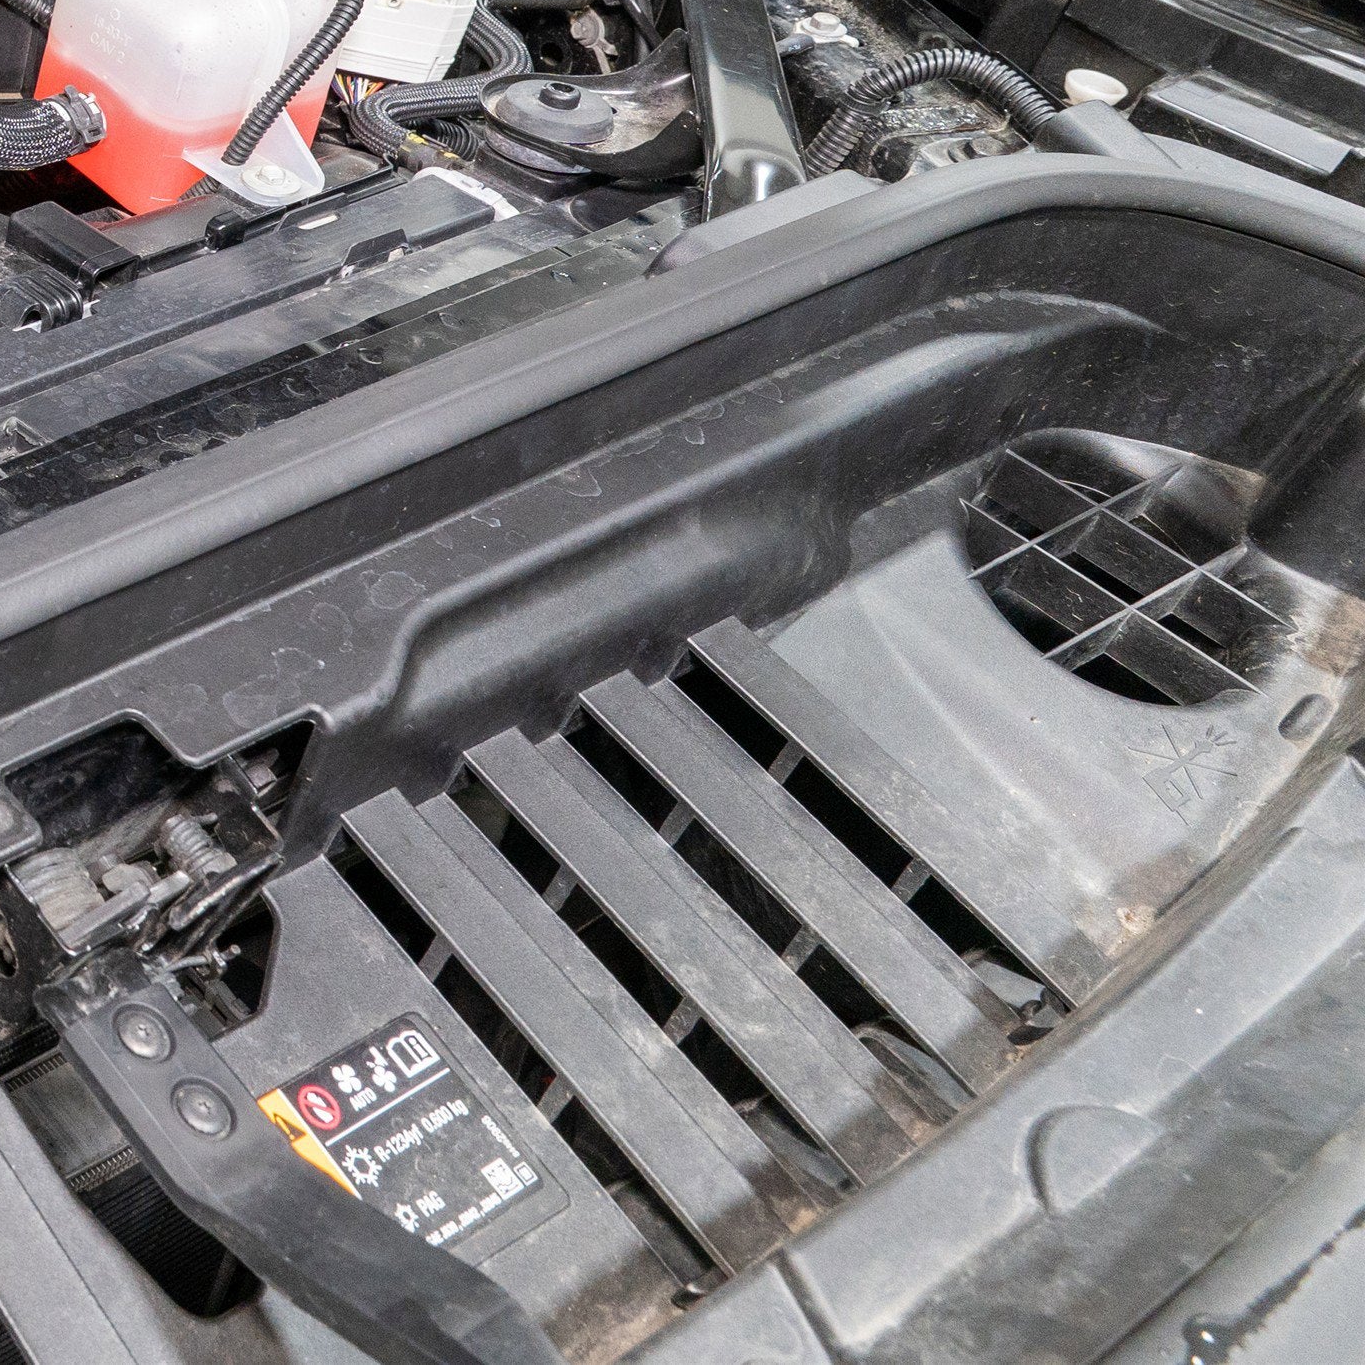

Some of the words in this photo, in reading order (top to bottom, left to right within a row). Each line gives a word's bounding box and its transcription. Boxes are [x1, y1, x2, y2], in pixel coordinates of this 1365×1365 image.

[349, 1087, 377, 1112] AUTO
[373, 1123, 424, 1163] R-1234yf
[421, 1105, 454, 1134] 0.600
[447, 1099, 470, 1117] kg
[416, 1190, 446, 1218] PAG
